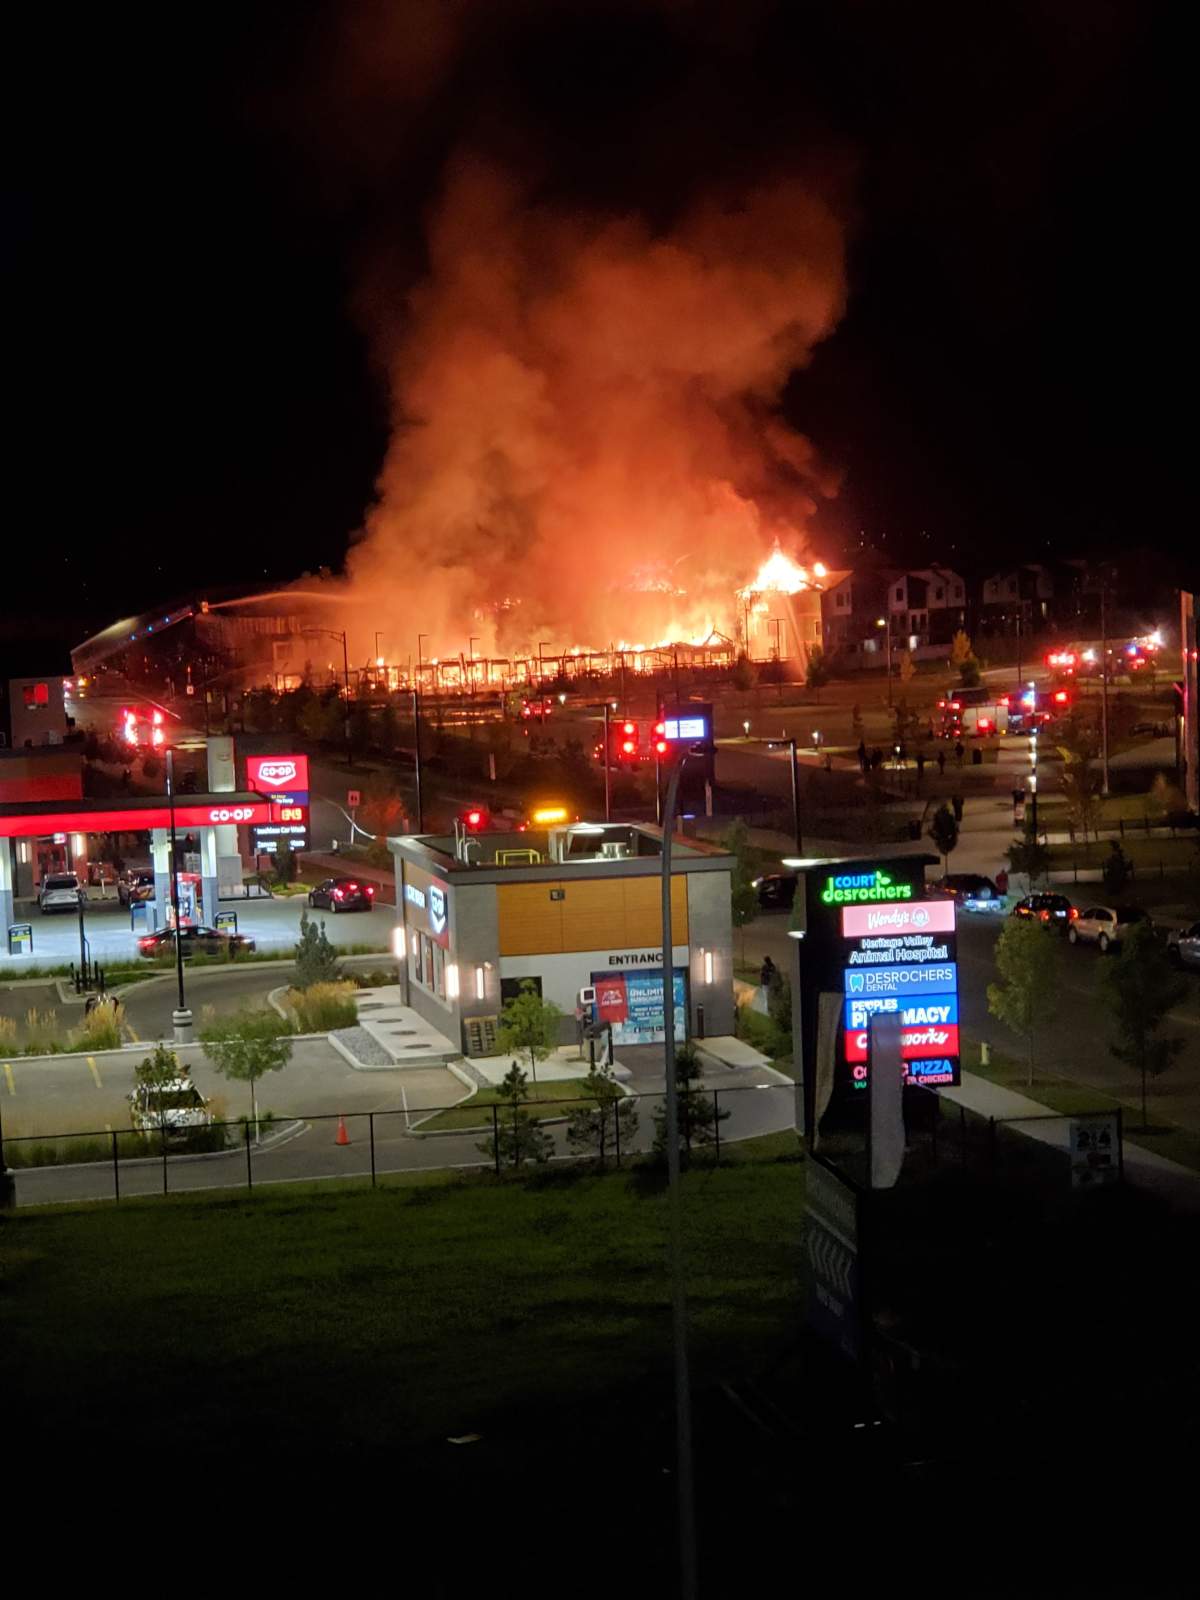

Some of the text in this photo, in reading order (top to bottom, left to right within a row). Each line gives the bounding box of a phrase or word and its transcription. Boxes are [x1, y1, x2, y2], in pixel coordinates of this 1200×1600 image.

[823, 874, 911, 902] desrochers
[835, 875, 876, 888] COURT
[608, 953, 665, 966] ENTRANC
[849, 944, 948, 964] Animal Hospital
[866, 968, 953, 985] DESROCHERS
[866, 983, 898, 992] DENTAL
[911, 1060, 953, 1075] PIZZA
